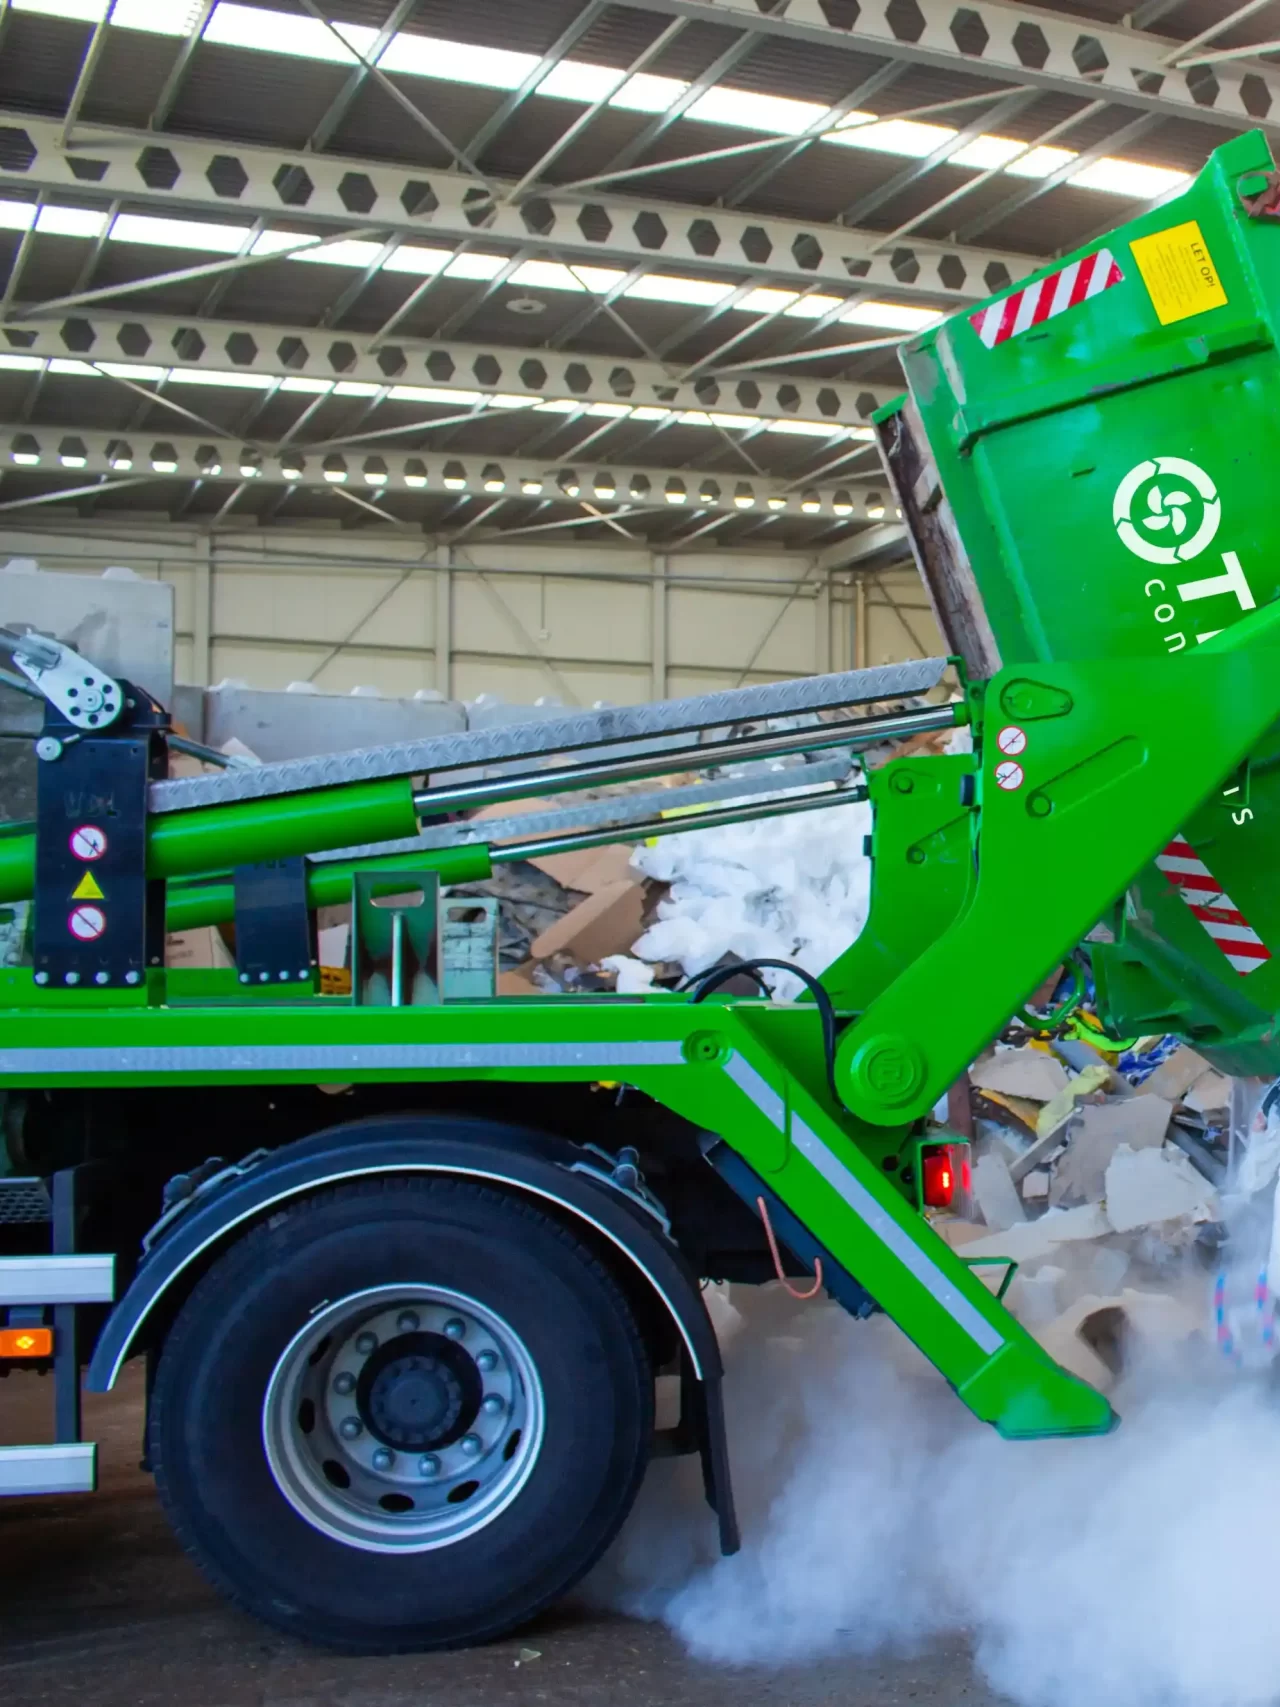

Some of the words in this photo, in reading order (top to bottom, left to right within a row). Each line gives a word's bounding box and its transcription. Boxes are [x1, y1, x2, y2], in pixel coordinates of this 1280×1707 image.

[1190, 242, 1206, 263] LET
[1200, 266, 1216, 288] OP!
[1176, 551, 1256, 644] T
